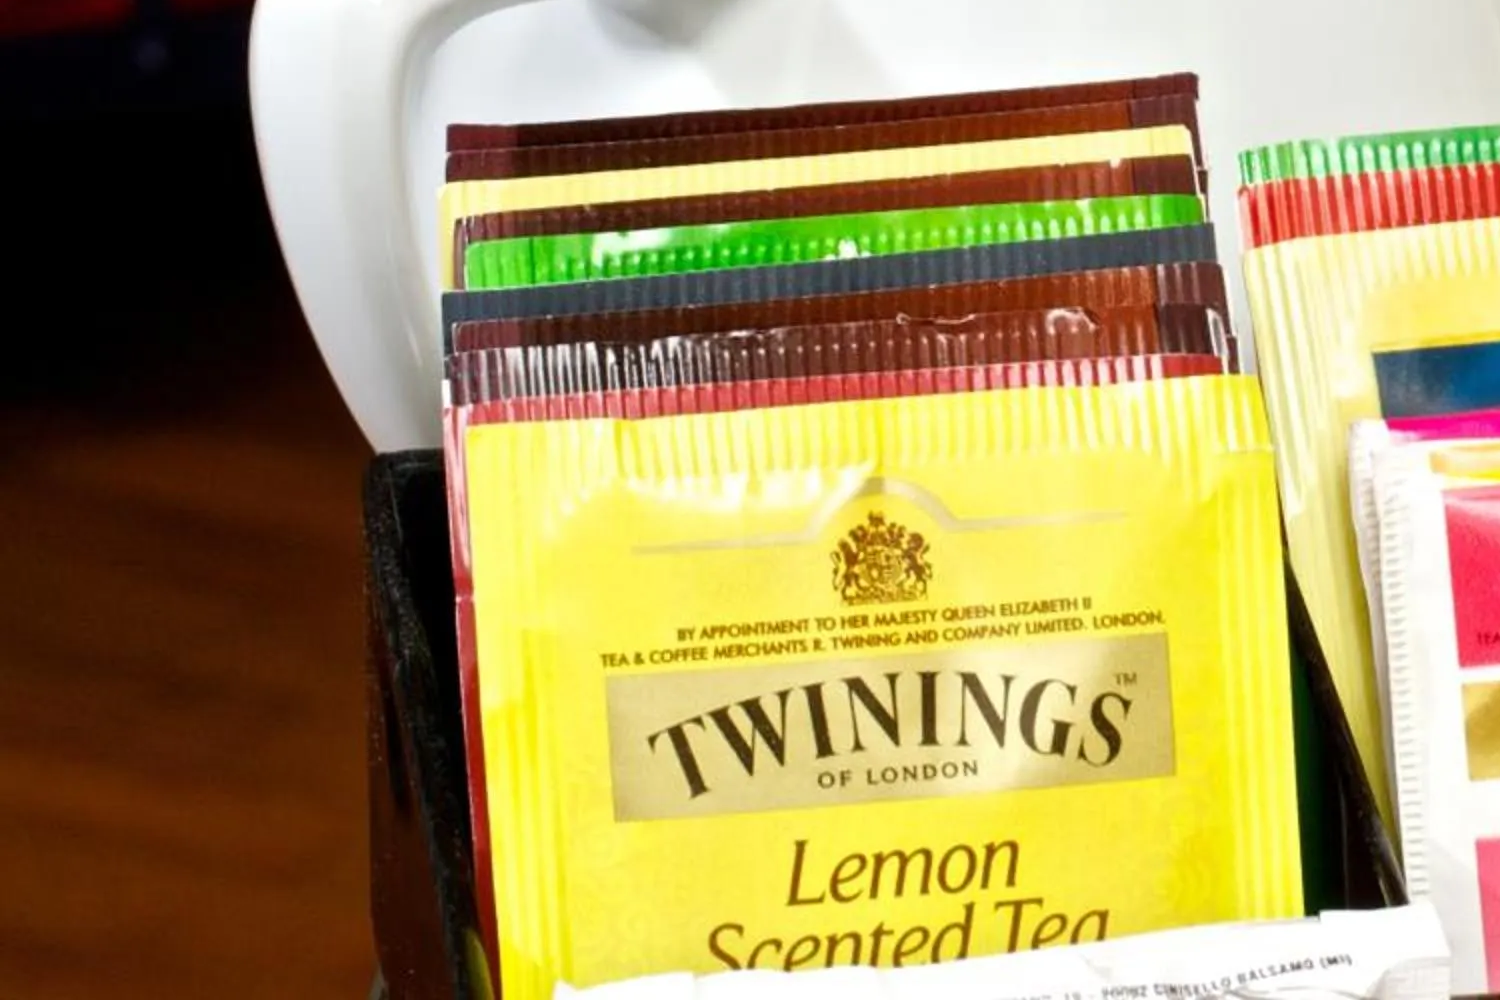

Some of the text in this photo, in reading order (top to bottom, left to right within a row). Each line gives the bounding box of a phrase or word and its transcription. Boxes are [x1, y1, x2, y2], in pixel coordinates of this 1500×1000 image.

[677, 596, 1092, 641] BY APPOINTMENT TO HER MAJESTY QUEEN ELIZABETH II
[601, 653, 630, 668] TEA
[634, 651, 645, 665] &
[649, 646, 708, 664] COFFEE
[713, 639, 807, 658] MERCHANTS
[830, 631, 901, 650] TWINING
[904, 629, 938, 645] AND
[942, 622, 1022, 642] COMPANY
[647, 670, 1133, 799] TWININGS
[816, 760, 980, 790] OF LONDON
[786, 839, 1020, 907] Lemon
[708, 898, 1110, 972] Scented Tea
[1238, 957, 1314, 983] BALSAMO
